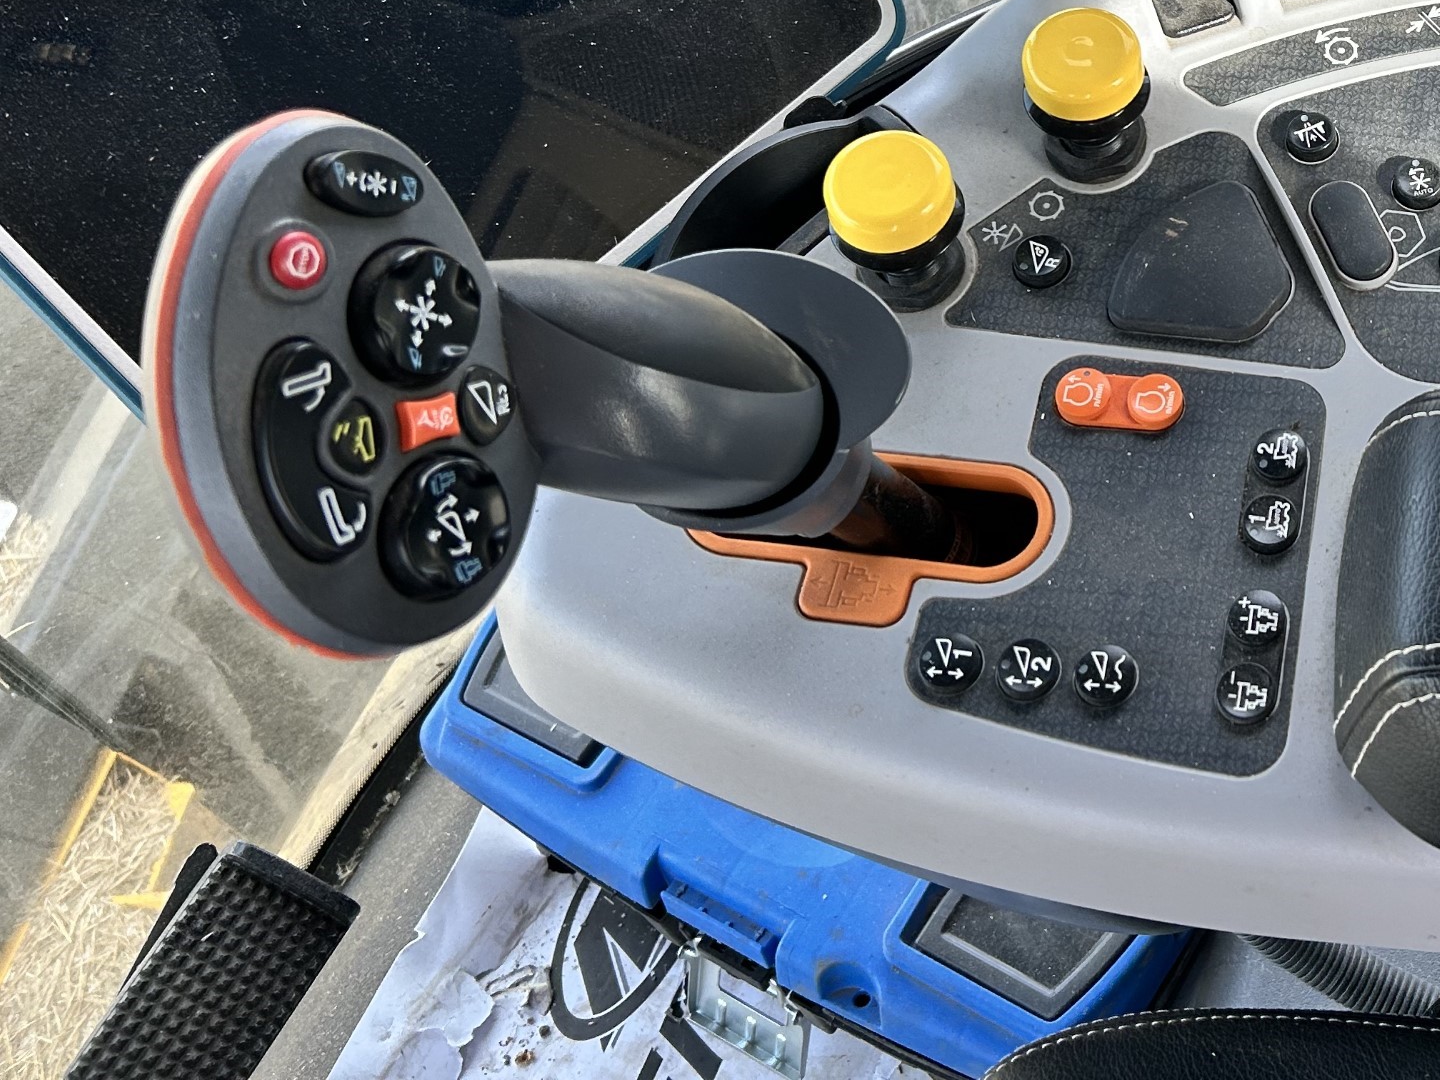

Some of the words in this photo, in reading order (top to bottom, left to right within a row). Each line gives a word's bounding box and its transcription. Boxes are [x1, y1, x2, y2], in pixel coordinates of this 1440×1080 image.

[1413, 187, 1434, 197] AUTO
[1044, 257, 1061, 269] R
[1256, 442, 1275, 455] 2
[1248, 514, 1266, 524] 1
[953, 648, 973, 659] 1
[1031, 656, 1052, 672] 2
